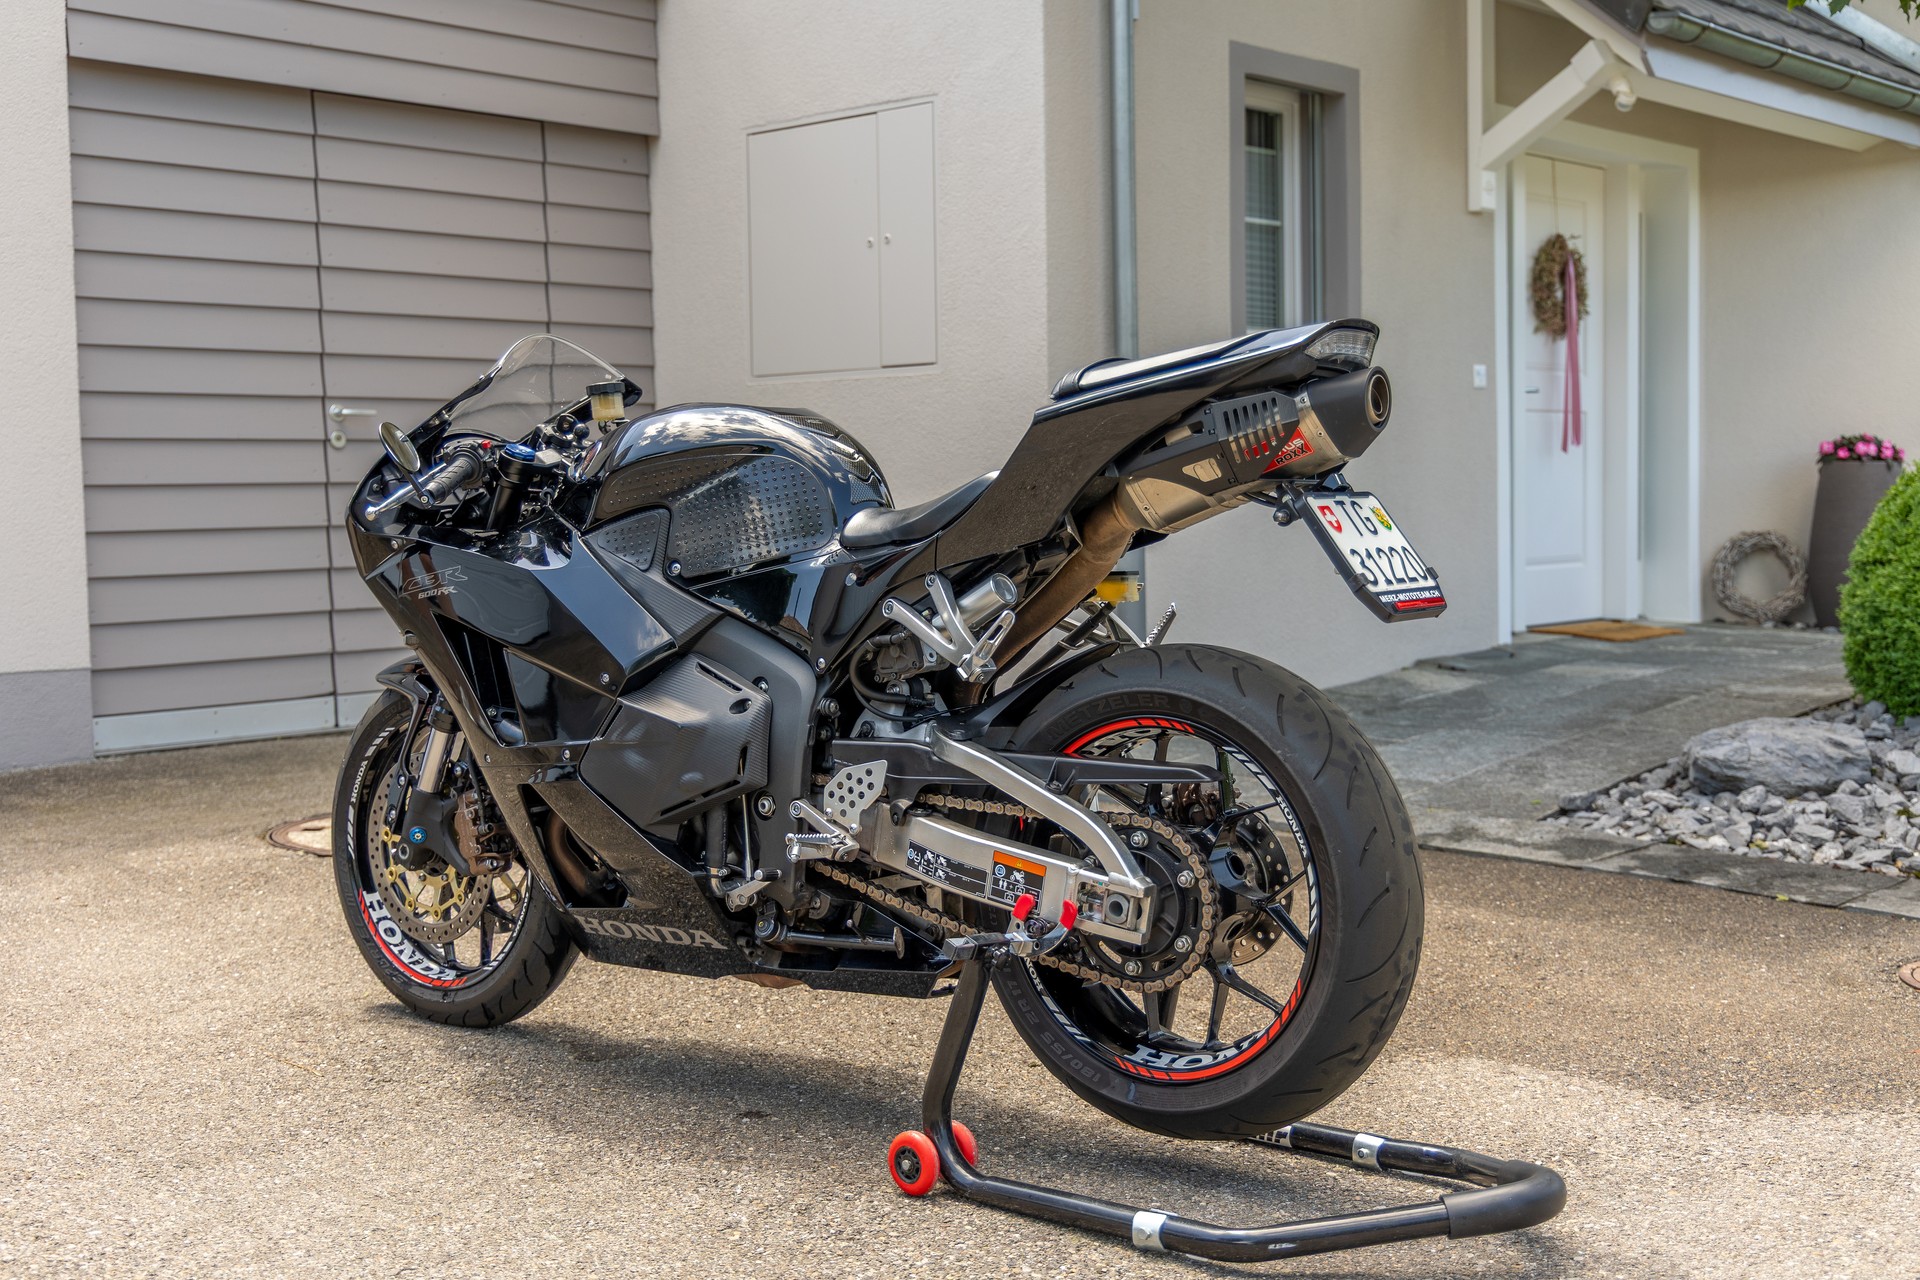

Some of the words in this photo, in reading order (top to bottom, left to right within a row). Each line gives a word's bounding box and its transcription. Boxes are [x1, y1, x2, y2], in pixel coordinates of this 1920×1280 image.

[1275, 443, 1308, 465] ROXX
[1334, 500, 1378, 536] TG
[1350, 546, 1428, 586] 31220
[418, 586, 458, 599] 600RR
[1379, 590, 1441, 602] MERZ-MOTOTEAM.CH
[1047, 693, 1171, 738] METZELER
[350, 760, 368, 803] HONDA
[1275, 795, 1308, 858] HONDA
[362, 890, 457, 980] HONDA
[573, 914, 728, 950] HONDA
[1040, 1031, 1102, 1083] 180/55
